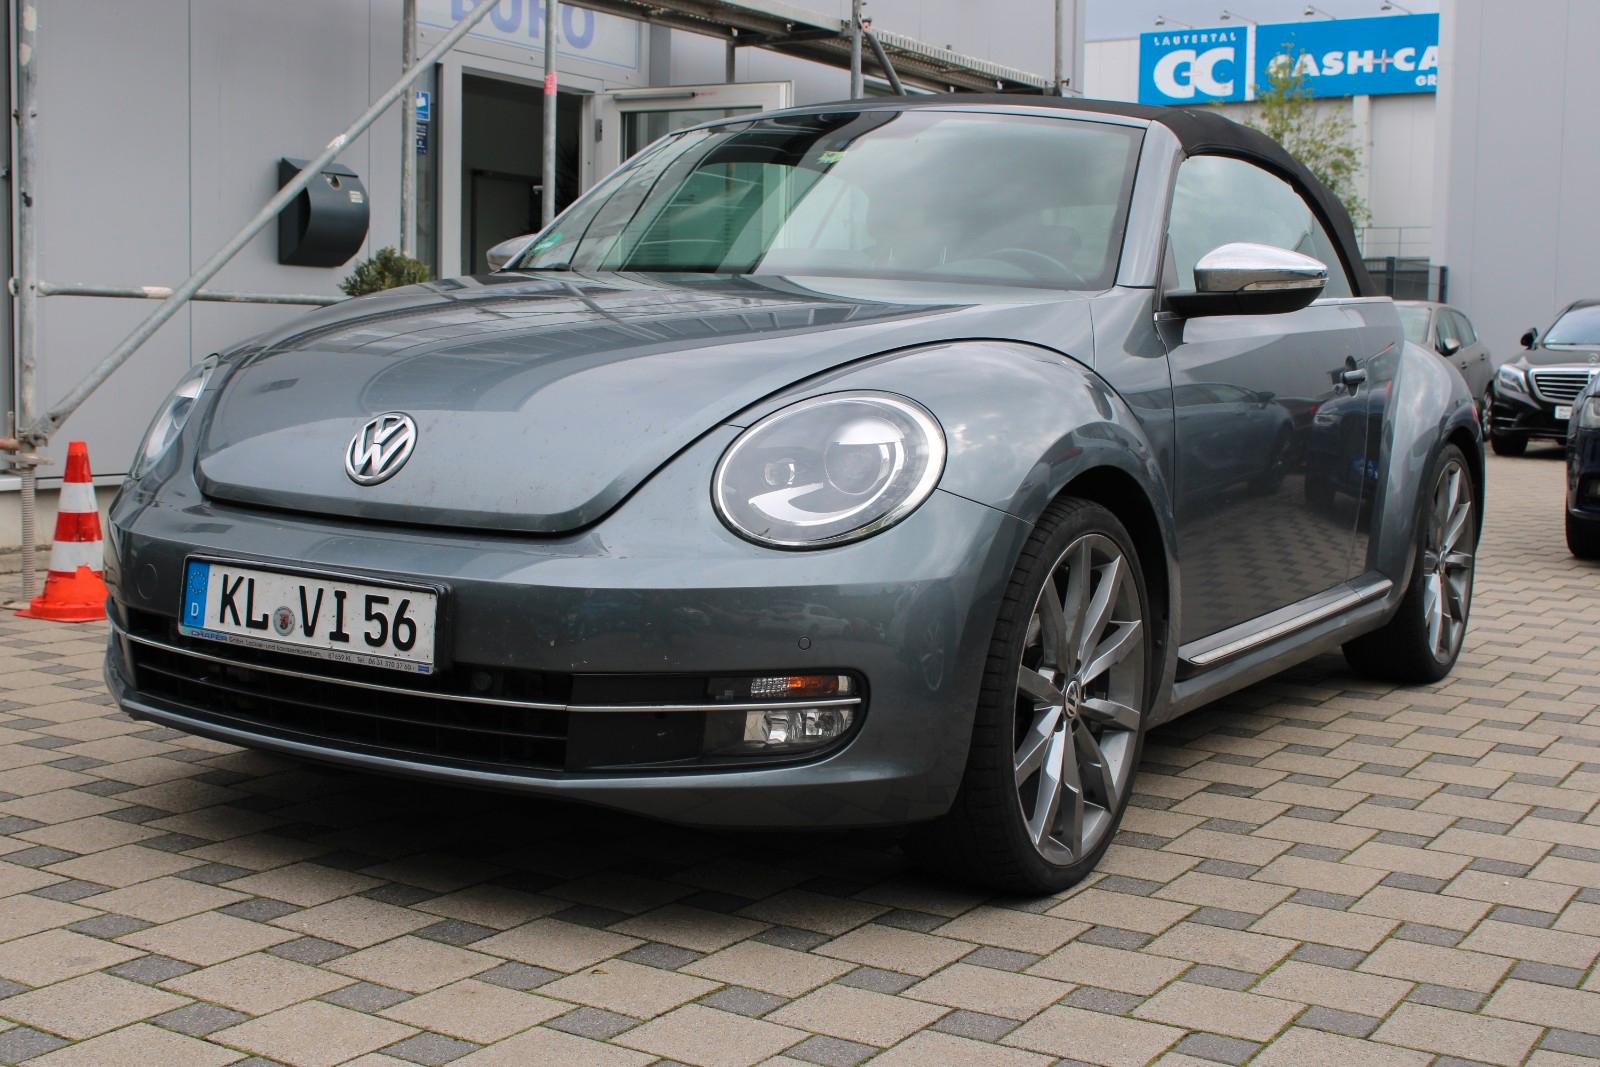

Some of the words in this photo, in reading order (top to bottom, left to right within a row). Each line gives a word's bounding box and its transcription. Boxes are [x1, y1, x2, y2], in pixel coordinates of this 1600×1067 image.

[1154, 32, 1236, 46] LAUTERTAL
[191, 602, 199, 617] D
[219, 574, 269, 630] KL
[299, 585, 350, 643] VI
[364, 594, 417, 651] 56
